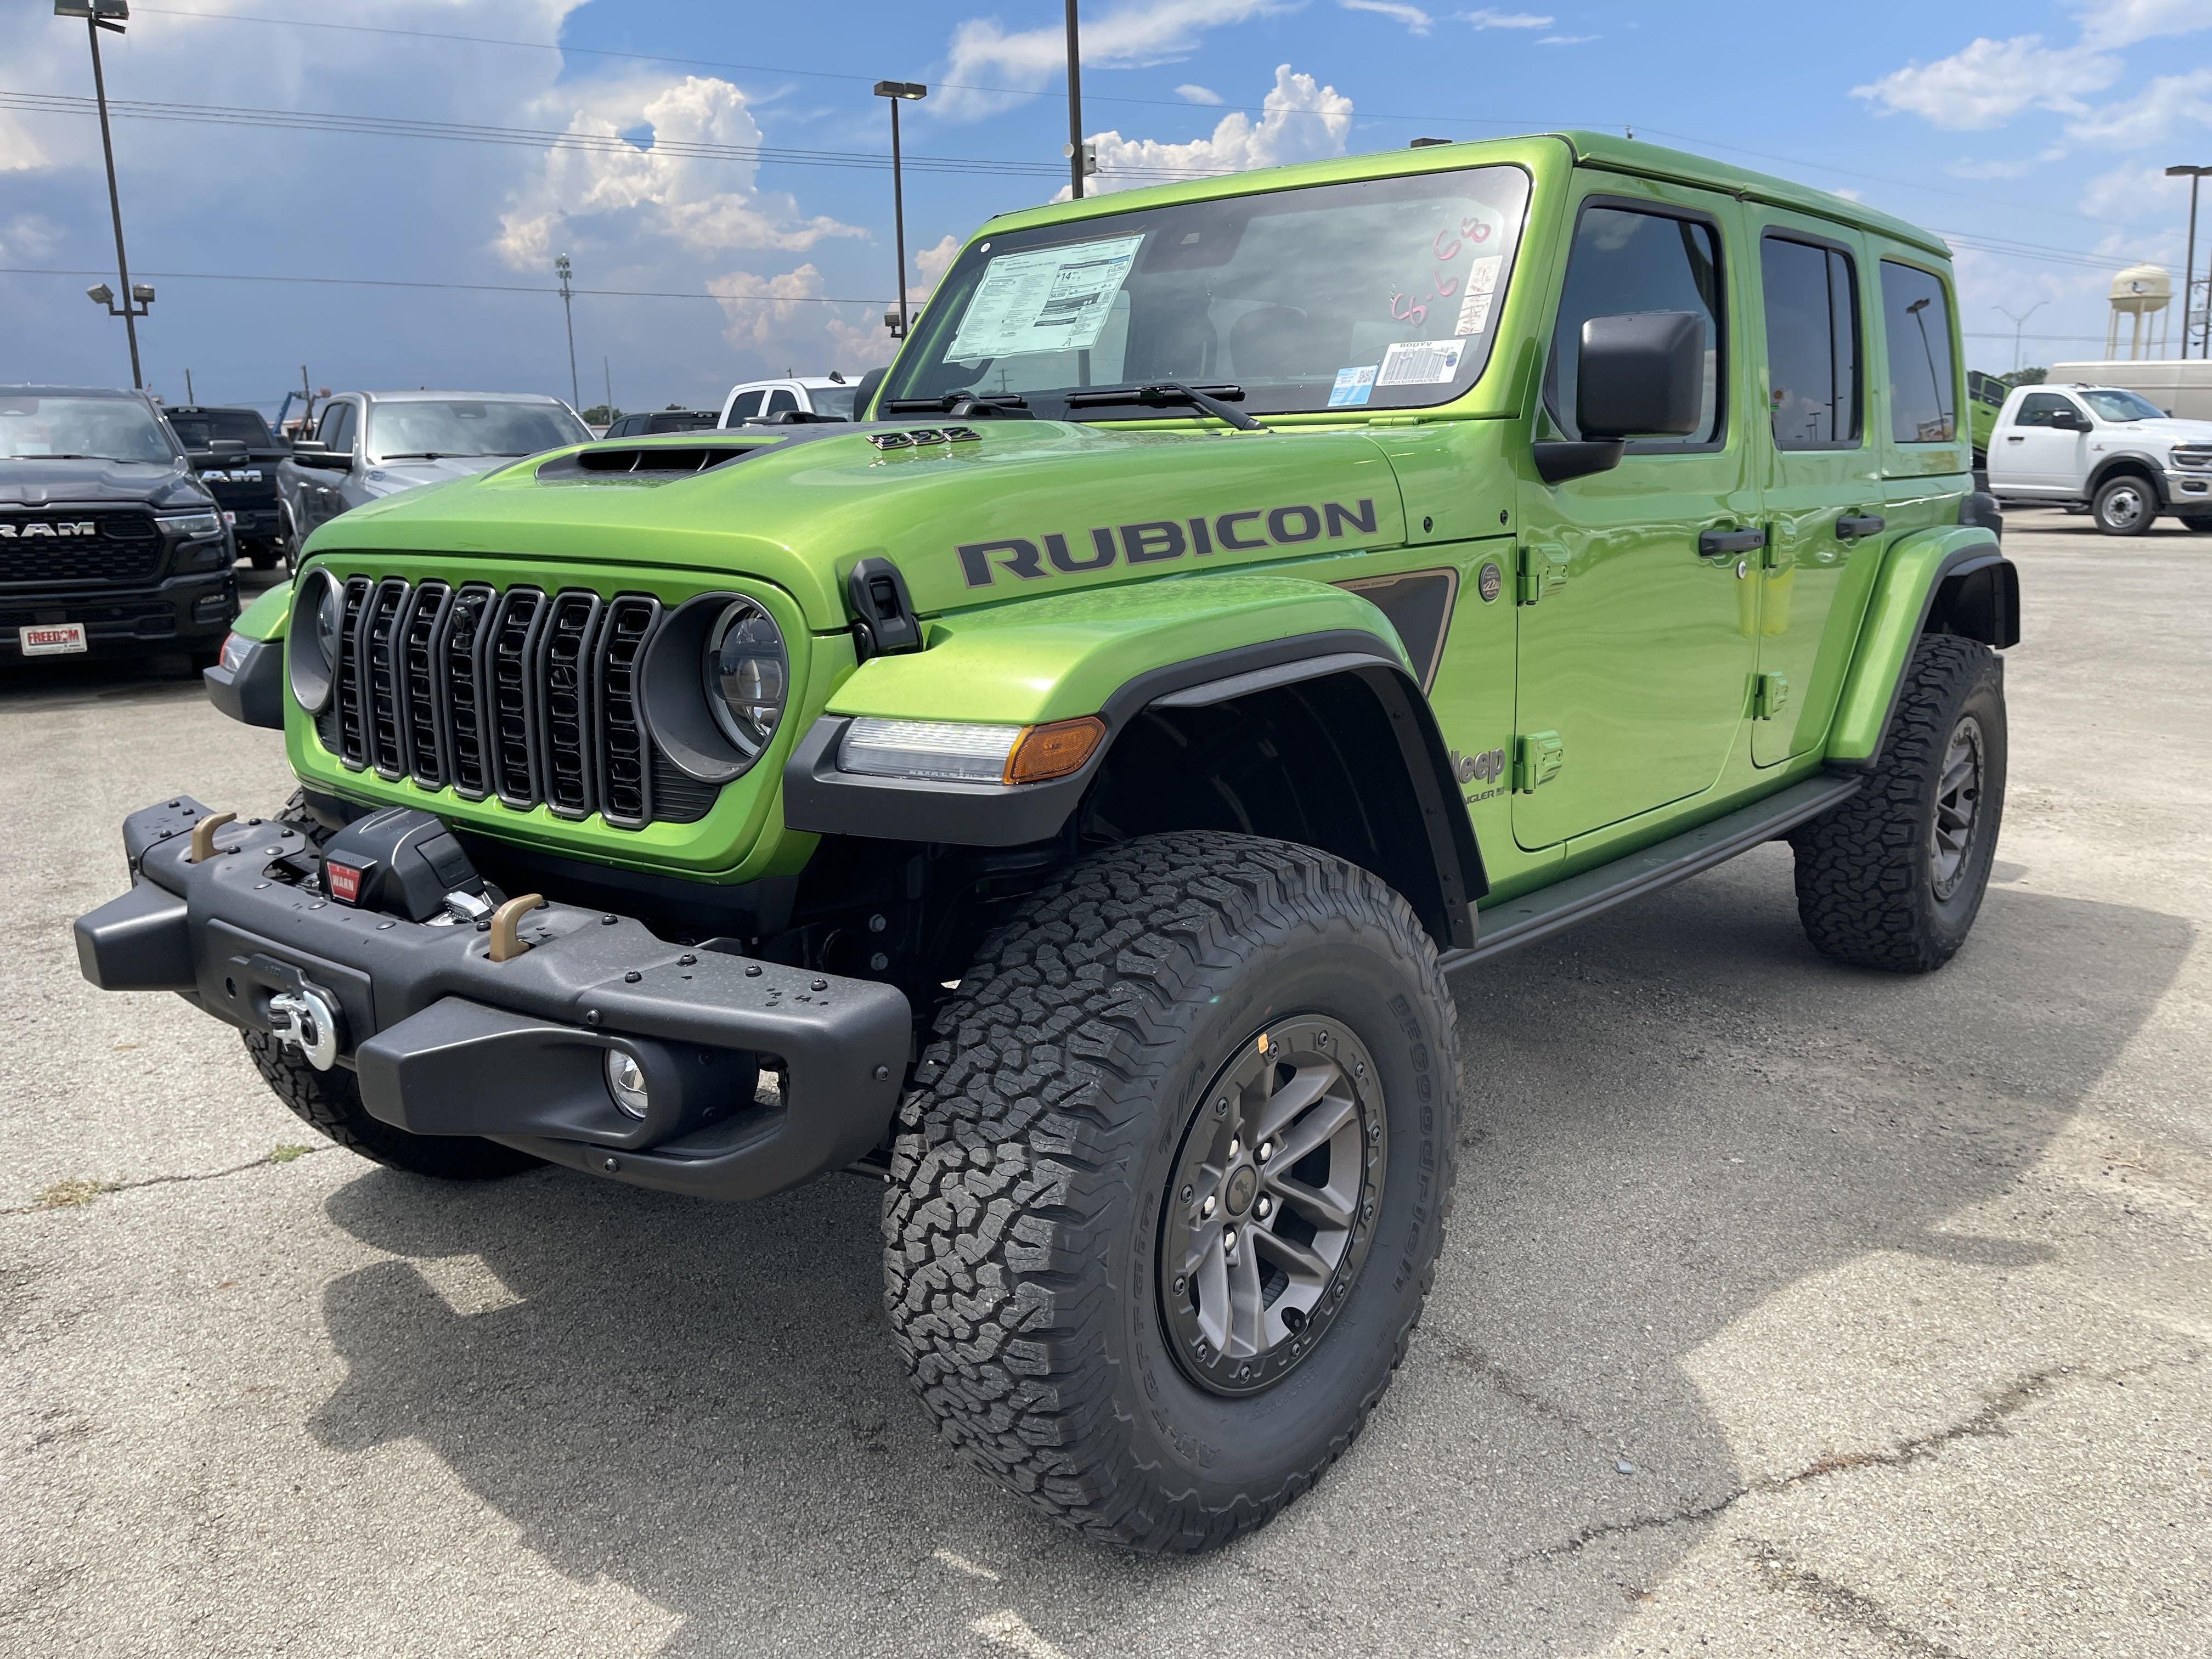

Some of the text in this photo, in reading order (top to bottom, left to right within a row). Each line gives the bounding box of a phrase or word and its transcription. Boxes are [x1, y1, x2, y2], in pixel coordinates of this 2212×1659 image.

[1062, 272, 1072, 281] 14
[200, 470, 263, 483] AM
[0, 522, 95, 538] RAM
[955, 497, 1379, 589] RUBICON
[332, 874, 354, 891] WARN
